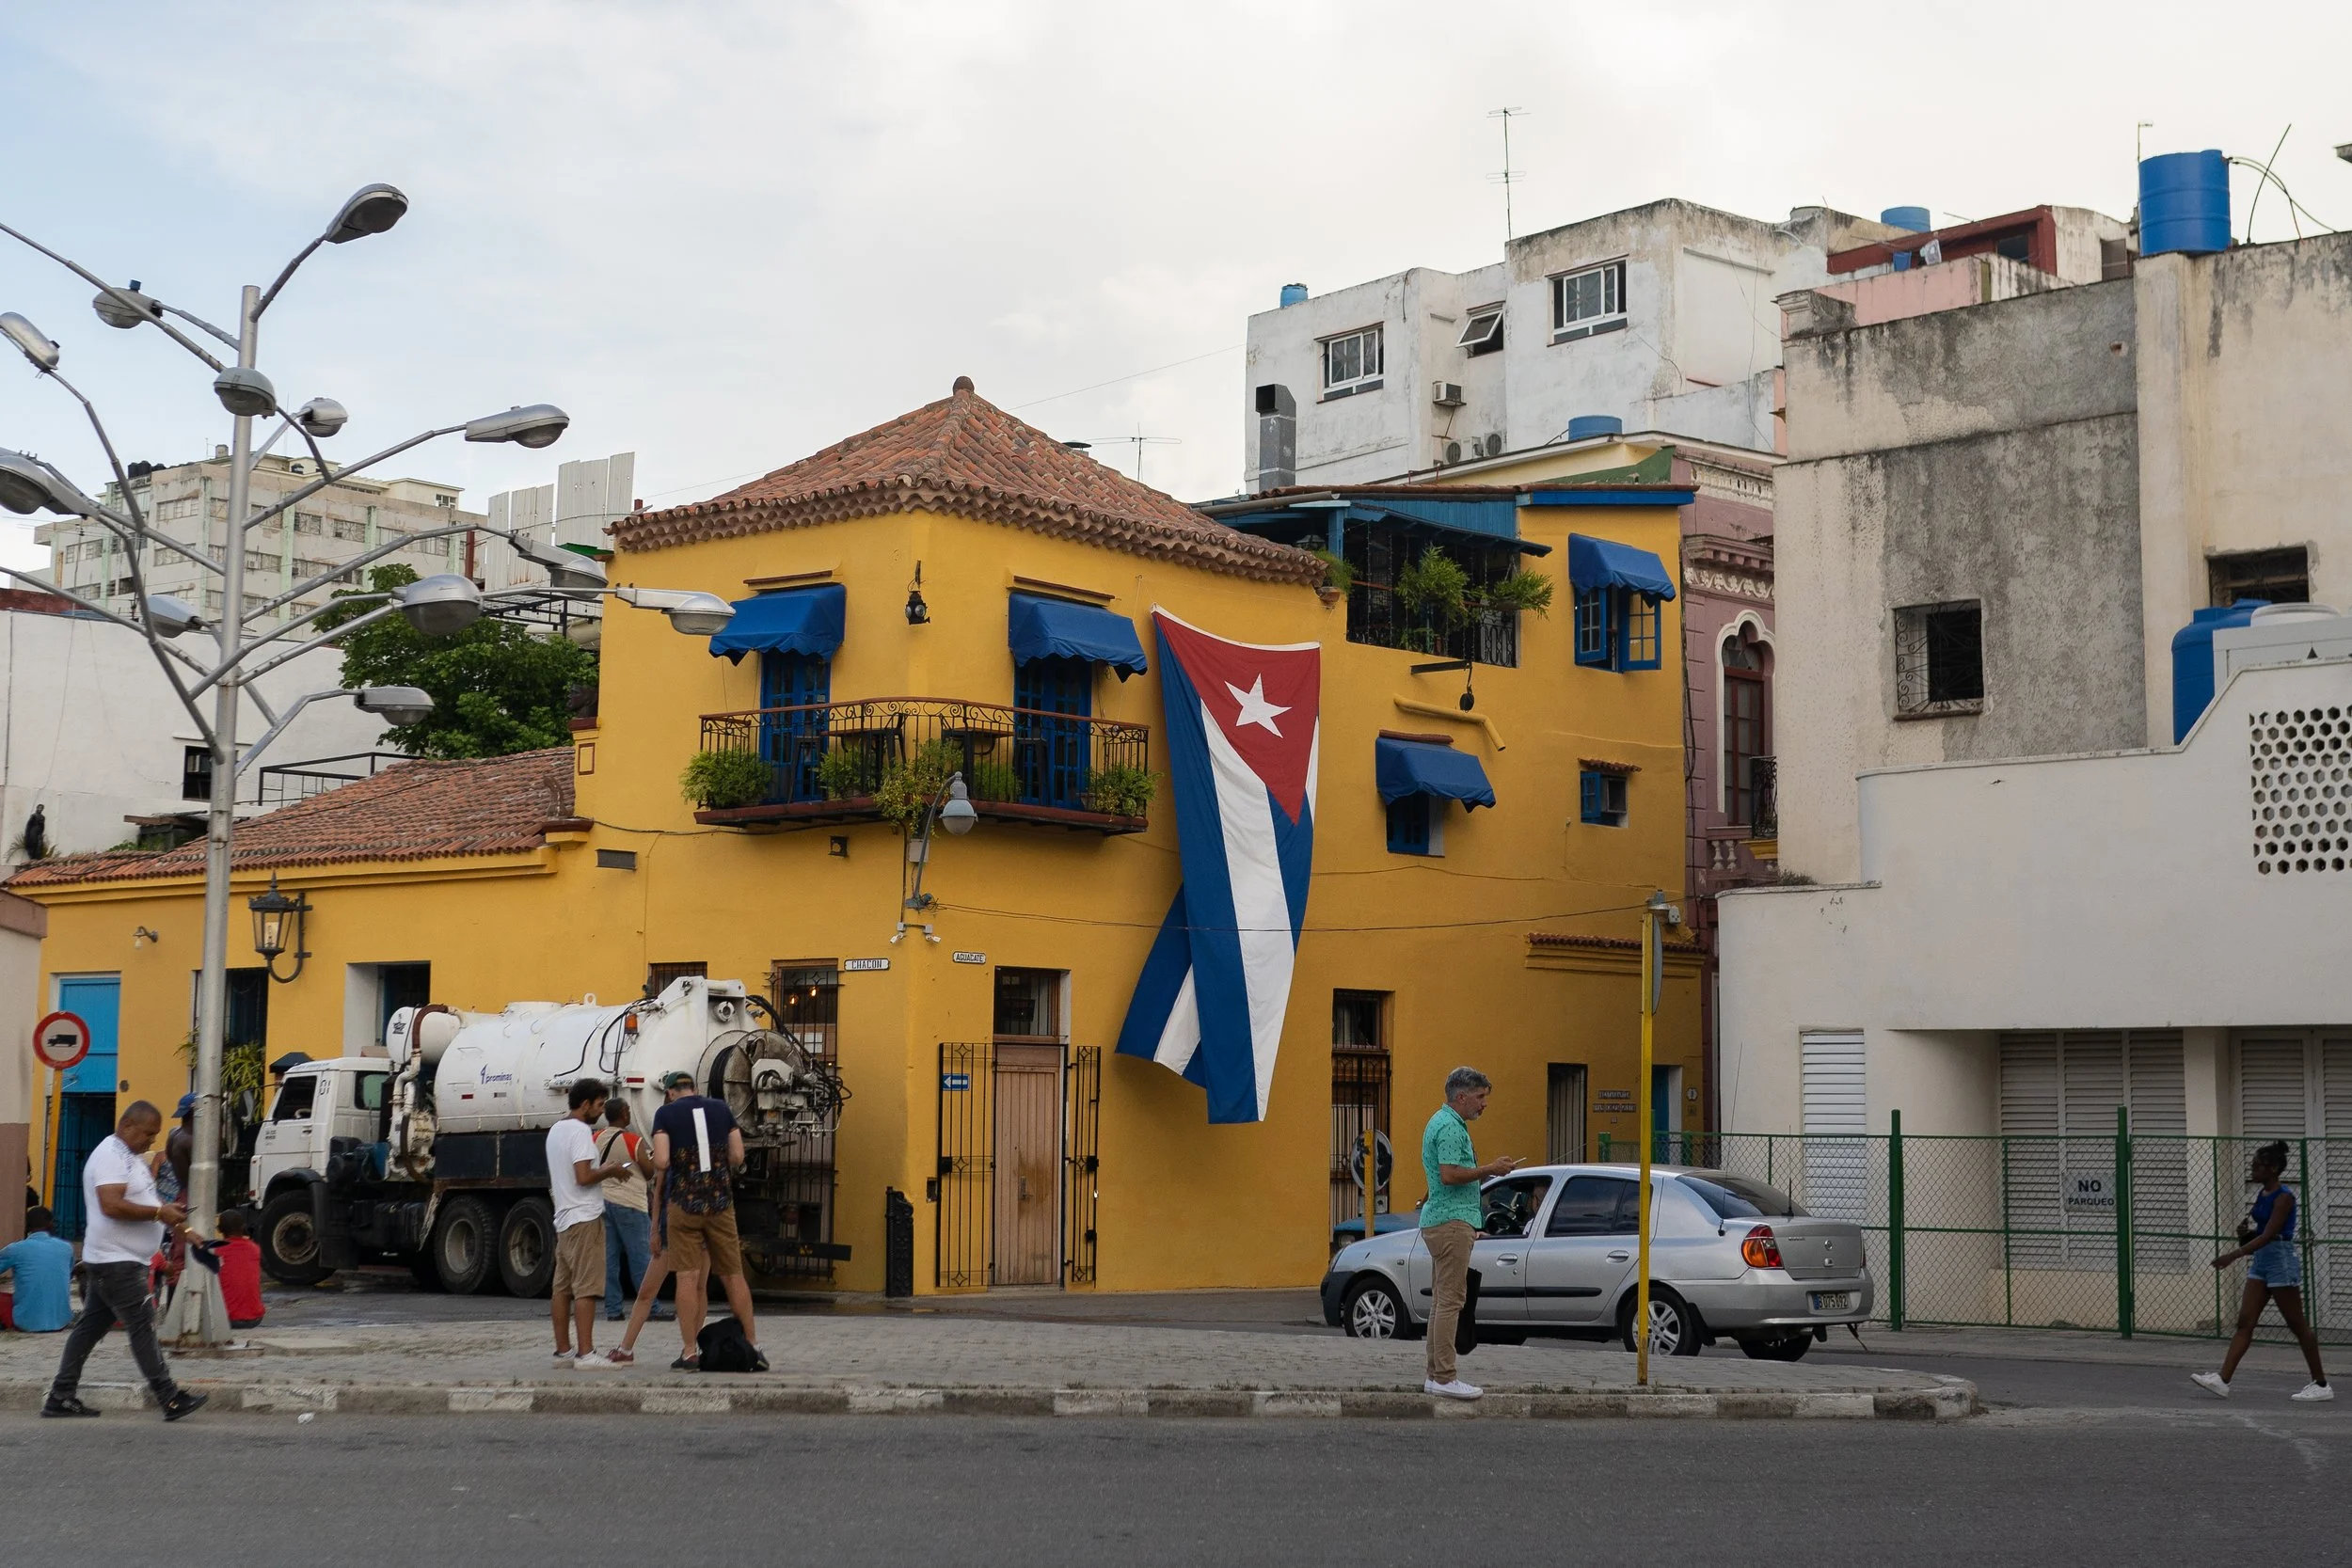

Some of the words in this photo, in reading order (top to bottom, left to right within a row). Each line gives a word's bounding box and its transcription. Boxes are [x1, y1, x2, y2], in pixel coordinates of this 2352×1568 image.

[956, 953, 984, 962] AGUACATE
[851, 959, 882, 970] CHACON
[2077, 1180, 2102, 1193] NO
[2068, 1197, 2115, 1206] PARQUEO
